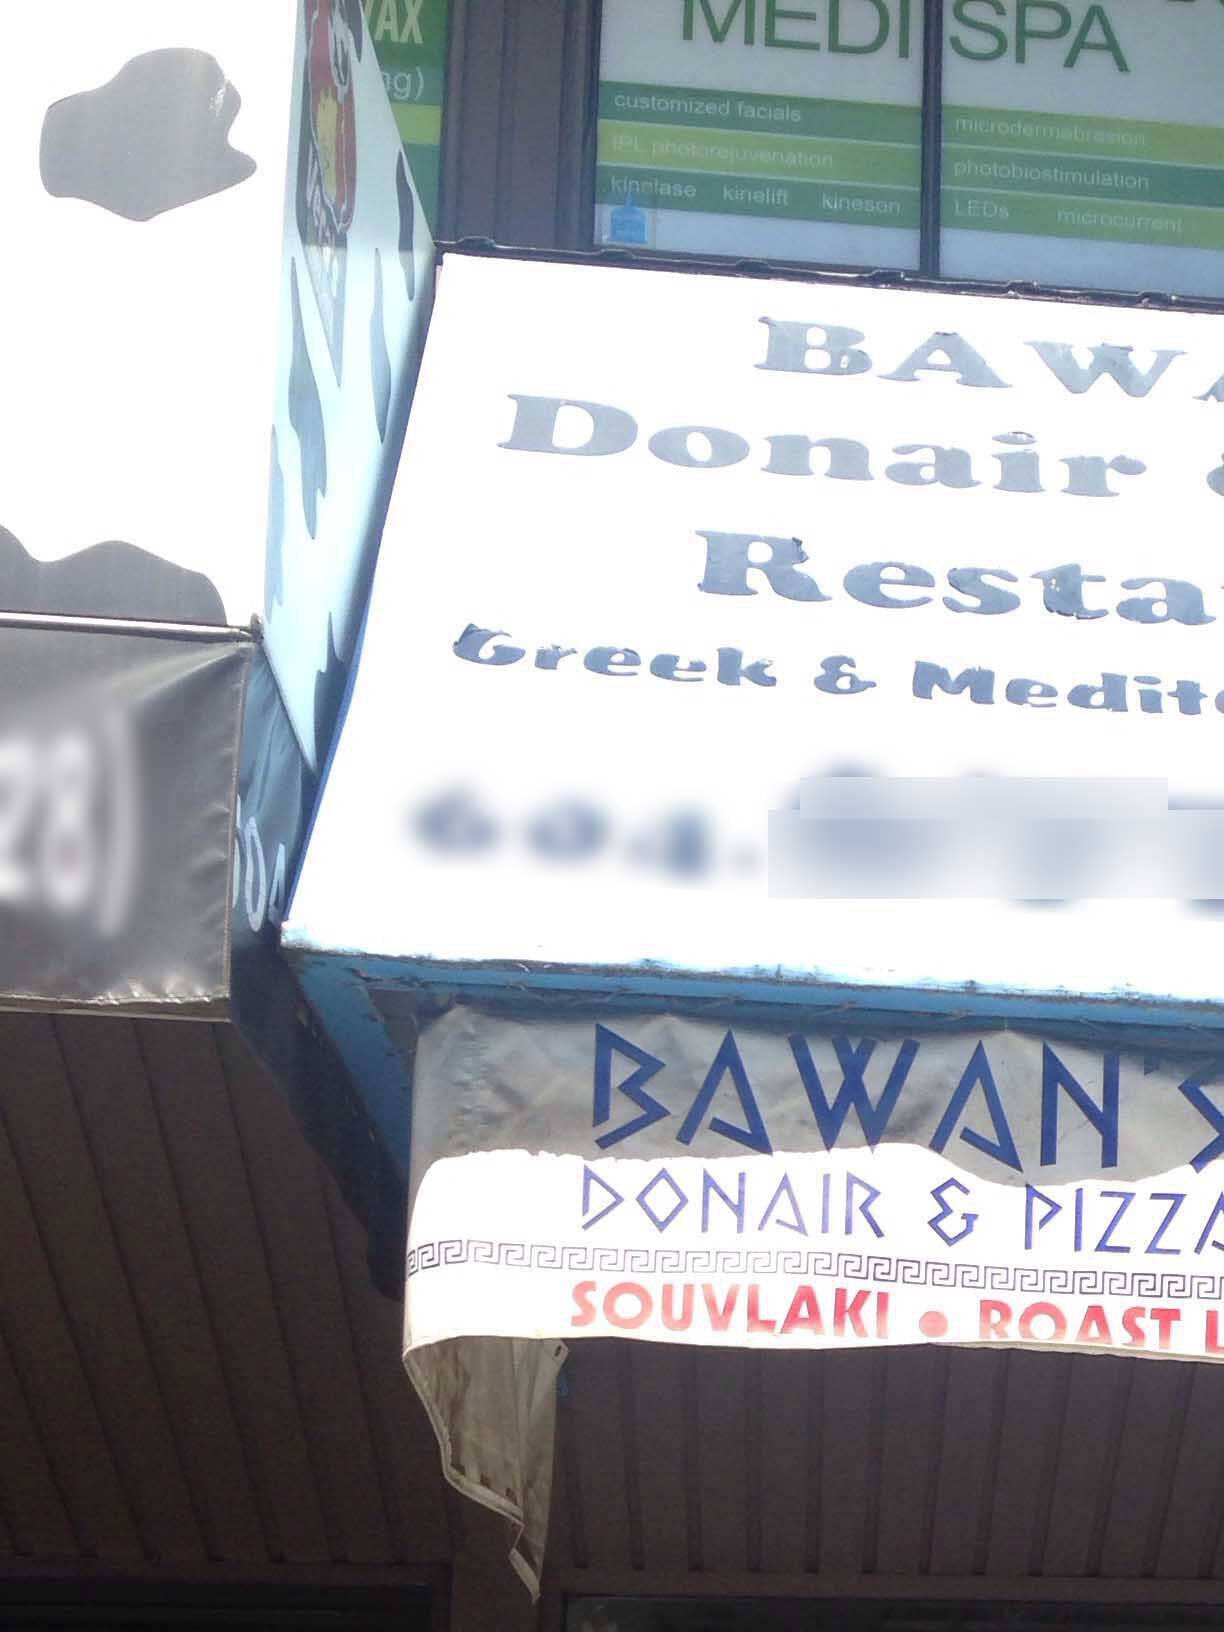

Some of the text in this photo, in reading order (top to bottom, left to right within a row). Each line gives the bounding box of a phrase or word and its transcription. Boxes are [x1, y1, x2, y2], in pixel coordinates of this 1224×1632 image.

[363, 0, 423, 44] AX
[682, 0, 1131, 73] MEDI SPA
[614, 93, 802, 123] customized facials
[955, 116, 1146, 147] microdermabrasion
[651, 140, 834, 170] photorejuvenation
[953, 158, 1149, 191] photobiostimulation
[722, 184, 790, 207] kinelift
[821, 192, 902, 215] kineson
[954, 199, 1185, 233] LEDs microcurrent
[496, 393, 1148, 499] Donair
[452, 622, 779, 689] Greek
[813, 655, 877, 695] &
[580, 1165, 888, 1240] DONAIR
[927, 1177, 981, 1248] &
[570, 1280, 891, 1341] SOUVLAKI
[979, 1297, 1186, 1350] ROAST
